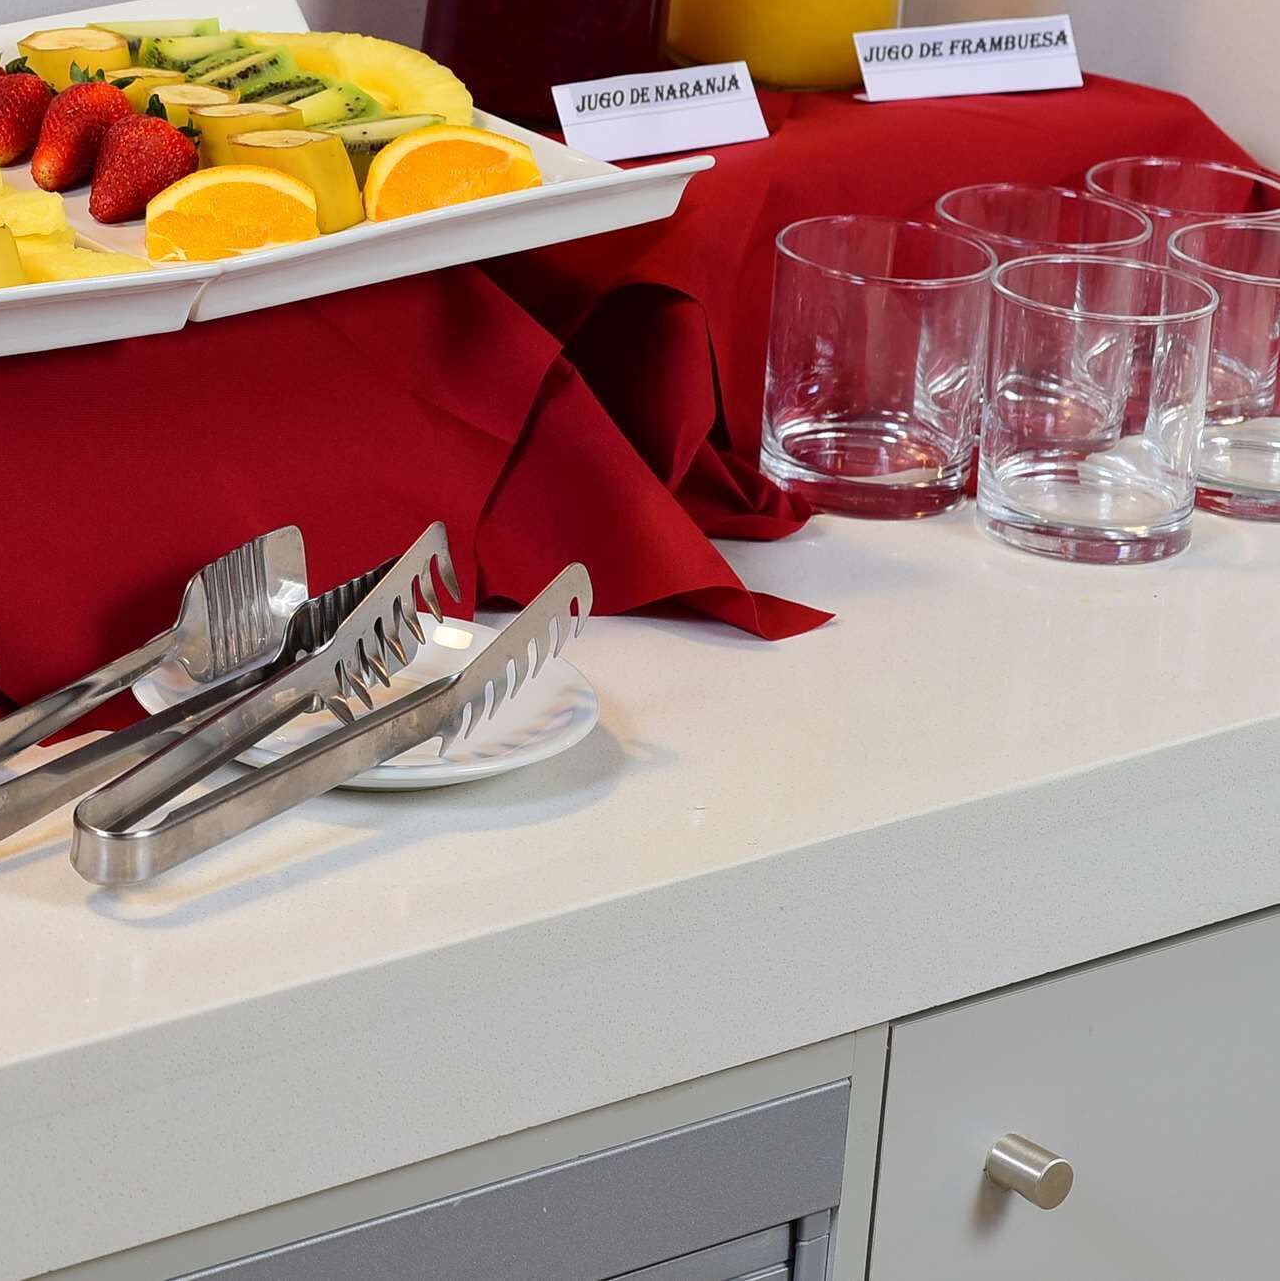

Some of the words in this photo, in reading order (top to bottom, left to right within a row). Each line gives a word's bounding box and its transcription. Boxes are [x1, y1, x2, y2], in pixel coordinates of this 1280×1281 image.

[863, 45, 913, 62] JUGO
[919, 41, 944, 58] DE
[949, 30, 1068, 55] FRAMBUESA
[575, 89, 625, 113] JUGO
[630, 86, 650, 105] DE
[654, 74, 740, 102] NARANJA
